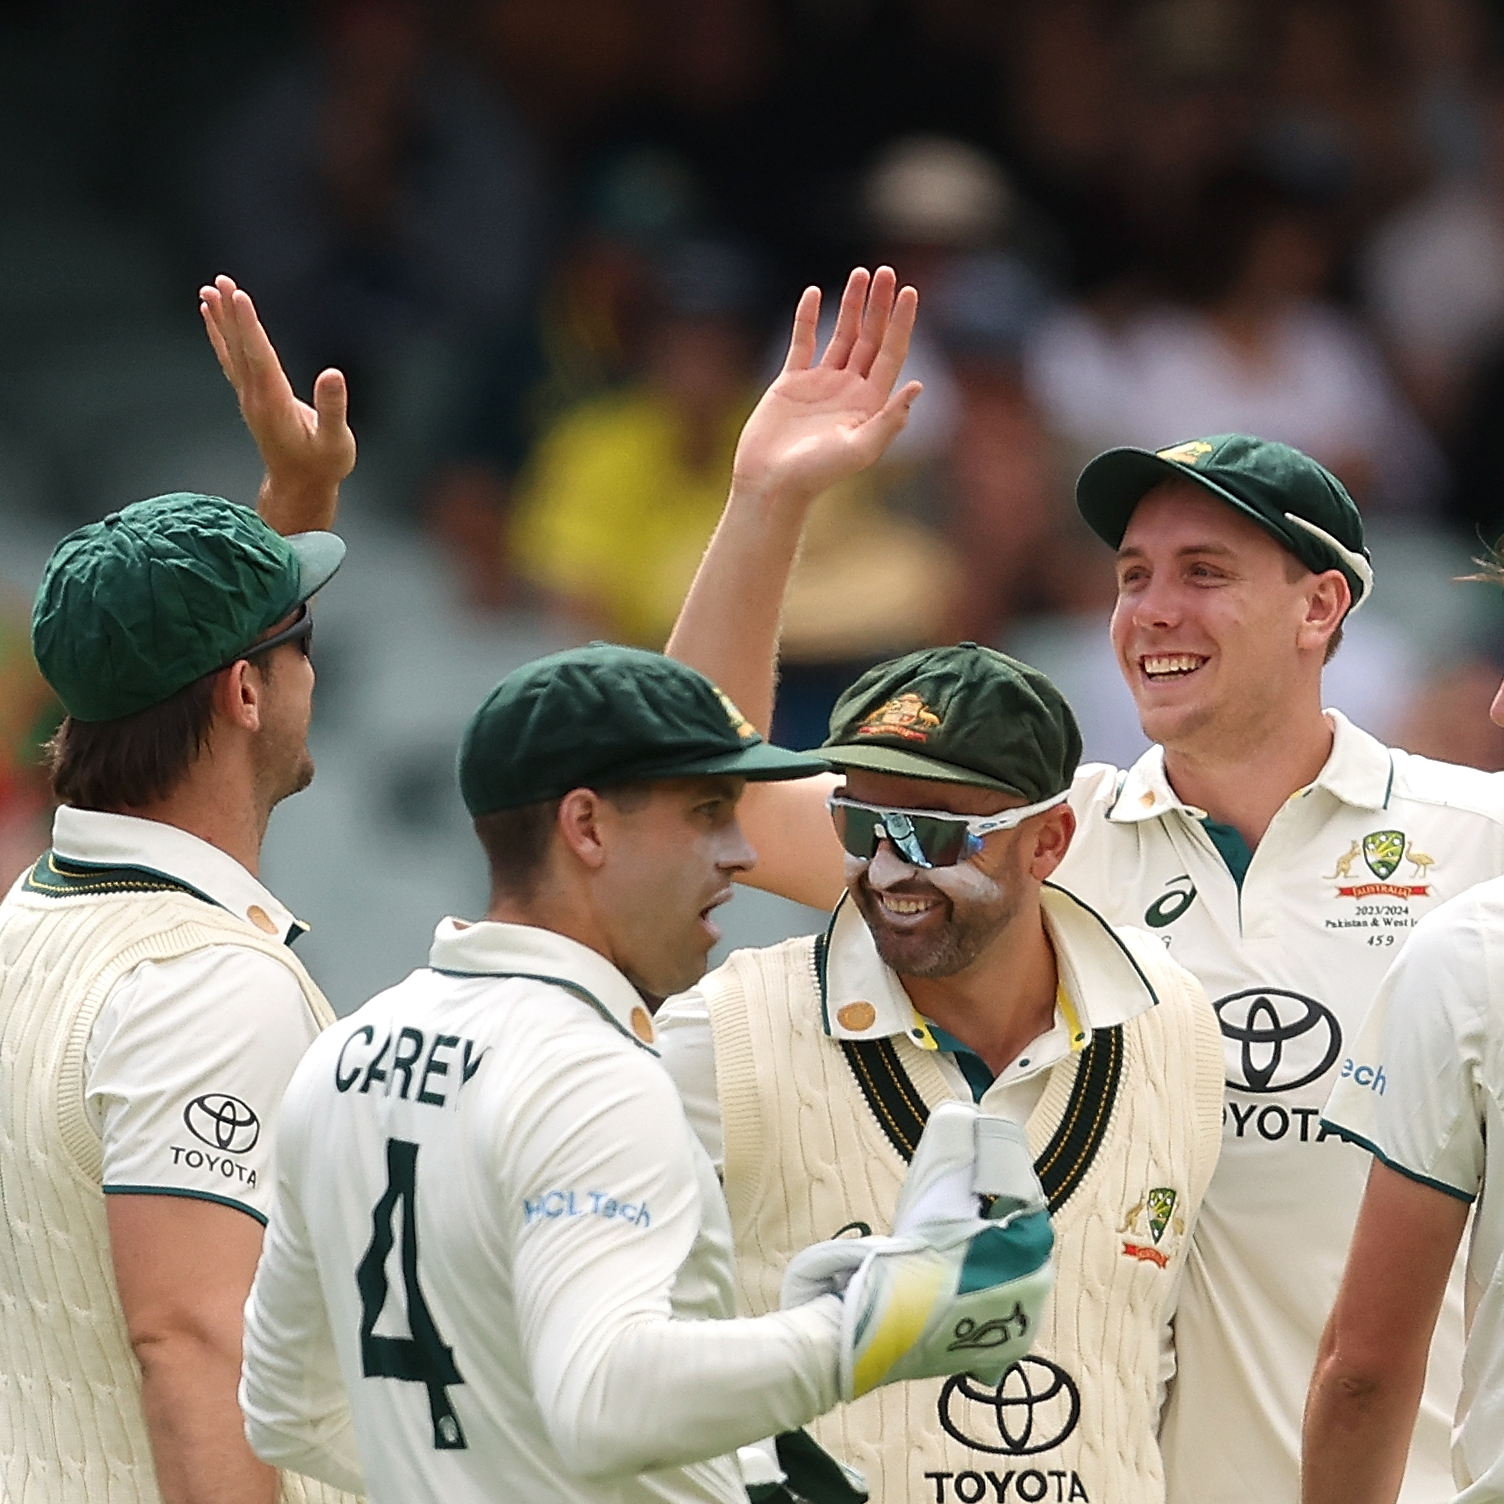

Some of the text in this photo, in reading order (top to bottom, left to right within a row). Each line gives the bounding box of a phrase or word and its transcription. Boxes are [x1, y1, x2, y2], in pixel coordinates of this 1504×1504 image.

[1325, 919, 1368, 928] Pakistan
[1370, 918, 1379, 927] &
[1383, 918, 1408, 927] West
[1356, 906, 1409, 916] 2023/2024
[1367, 935, 1394, 946] 459
[335, 1025, 493, 1108] CAREY
[1222, 1102, 1355, 1143] YOT
[170, 1146, 257, 1189] TOYOTA
[356, 1137, 468, 1450] 4
[924, 1469, 1089, 1504] TOYOTA
